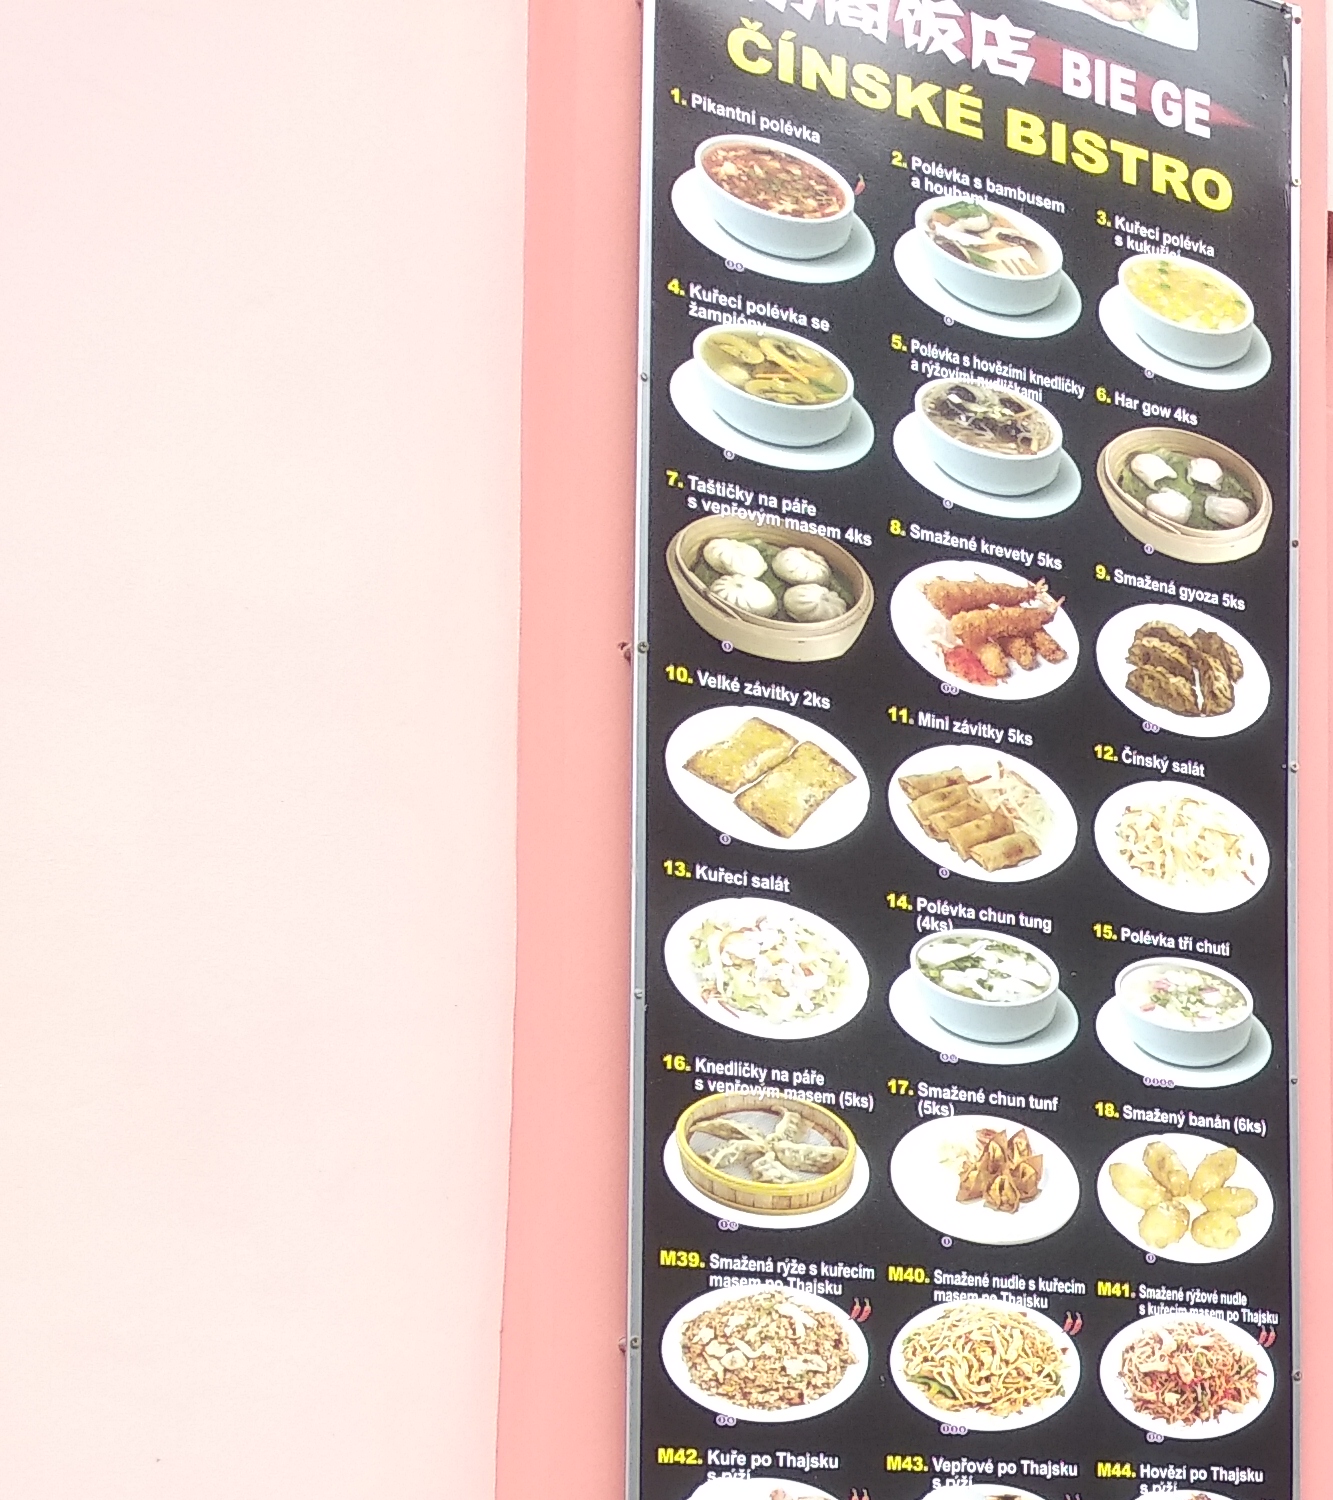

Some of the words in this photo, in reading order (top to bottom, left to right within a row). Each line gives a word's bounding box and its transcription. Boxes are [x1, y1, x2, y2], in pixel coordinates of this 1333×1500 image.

[1062, 43, 1136, 116] BIE
[1151, 79, 1212, 139] GE
[670, 87, 687, 106] 1.
[691, 93, 757, 125] Pikantní
[759, 115, 821, 144] polévka
[727, 16, 984, 140] ČÍNSKÉ
[1006, 108, 1234, 212] BISTRO
[891, 150, 908, 168] 2.
[911, 155, 970, 186] Polévka
[973, 177, 982, 189] s
[986, 176, 1065, 213] bambusem
[1096, 210, 1111, 226] 3.
[1114, 215, 1159, 242] Kuřecí
[1162, 231, 1215, 257] polévka
[667, 278, 685, 296] 4.
[689, 282, 742, 310] Kuřecí
[746, 299, 807, 327] polévka
[811, 316, 830, 332] se
[1095, 386, 1112, 404] 6.
[1114, 390, 1140, 411] Har
[1141, 401, 1172, 419] gow
[1173, 407, 1199, 426] 4ks
[667, 470, 684, 489] 7.
[687, 474, 754, 506] Taštičky
[758, 492, 778, 509] na
[781, 497, 817, 517] páře
[844, 527, 873, 547] 4ks
[889, 519, 906, 537] 8.
[980, 538, 1034, 567] krevety
[1037, 552, 1063, 570] 5ks
[1095, 564, 1110, 581] 9.
[1178, 586, 1219, 605] gyoza
[1221, 592, 1246, 611] 5ks
[665, 665, 694, 684] 10.
[696, 669, 741, 693] Velké
[743, 680, 800, 707] závitky
[802, 690, 831, 710] 2ks
[888, 707, 915, 725] 11.
[918, 712, 949, 730] Mini
[952, 718, 1005, 744] závitky
[1007, 727, 1034, 747] 5ks
[1094, 745, 1119, 762] 12.
[1172, 759, 1205, 778] salát
[663, 860, 692, 878] 13.
[695, 863, 749, 887] Kuřecí
[750, 874, 791, 893] salát
[886, 893, 912, 911] 14.
[916, 896, 976, 923] Polévka
[978, 906, 1016, 926] chun
[1018, 912, 1052, 934] tung
[1092, 923, 1118, 941] 15.
[1120, 926, 1176, 949] Polévka
[662, 1054, 690, 1072] 16.
[770, 1068, 790, 1083] na
[792, 1069, 825, 1087] páře
[839, 1091, 874, 1112] (5ks)
[887, 1079, 914, 1096] 17.
[989, 1091, 1025, 1106] chun
[1094, 1101, 1120, 1119] 18.
[1122, 1104, 1186, 1129] Smažený
[1188, 1111, 1231, 1131] banán
[1233, 1116, 1267, 1138] (6ks)
[659, 1249, 706, 1269] M39.
[776, 1257, 807, 1280] rýže
[808, 1263, 818, 1281] s
[888, 1265, 930, 1284] M40.
[991, 1274, 1027, 1295] nudle
[1028, 1278, 1037, 1296] s
[657, 1447, 703, 1465] M42.
[708, 1450, 746, 1466] Kuře
[751, 1455, 772, 1469] po
[776, 1452, 839, 1472] Thajsku
[886, 1455, 928, 1472] M43.
[931, 1456, 995, 1478] Vepřové
[997, 1461, 1017, 1478] po
[1020, 1459, 1078, 1480] Thajsku
[1097, 1461, 1137, 1479] M44.
[1139, 1463, 1187, 1485] Hovězí
[1189, 1468, 1208, 1484] po
[1210, 1466, 1264, 1486] Thajsku
